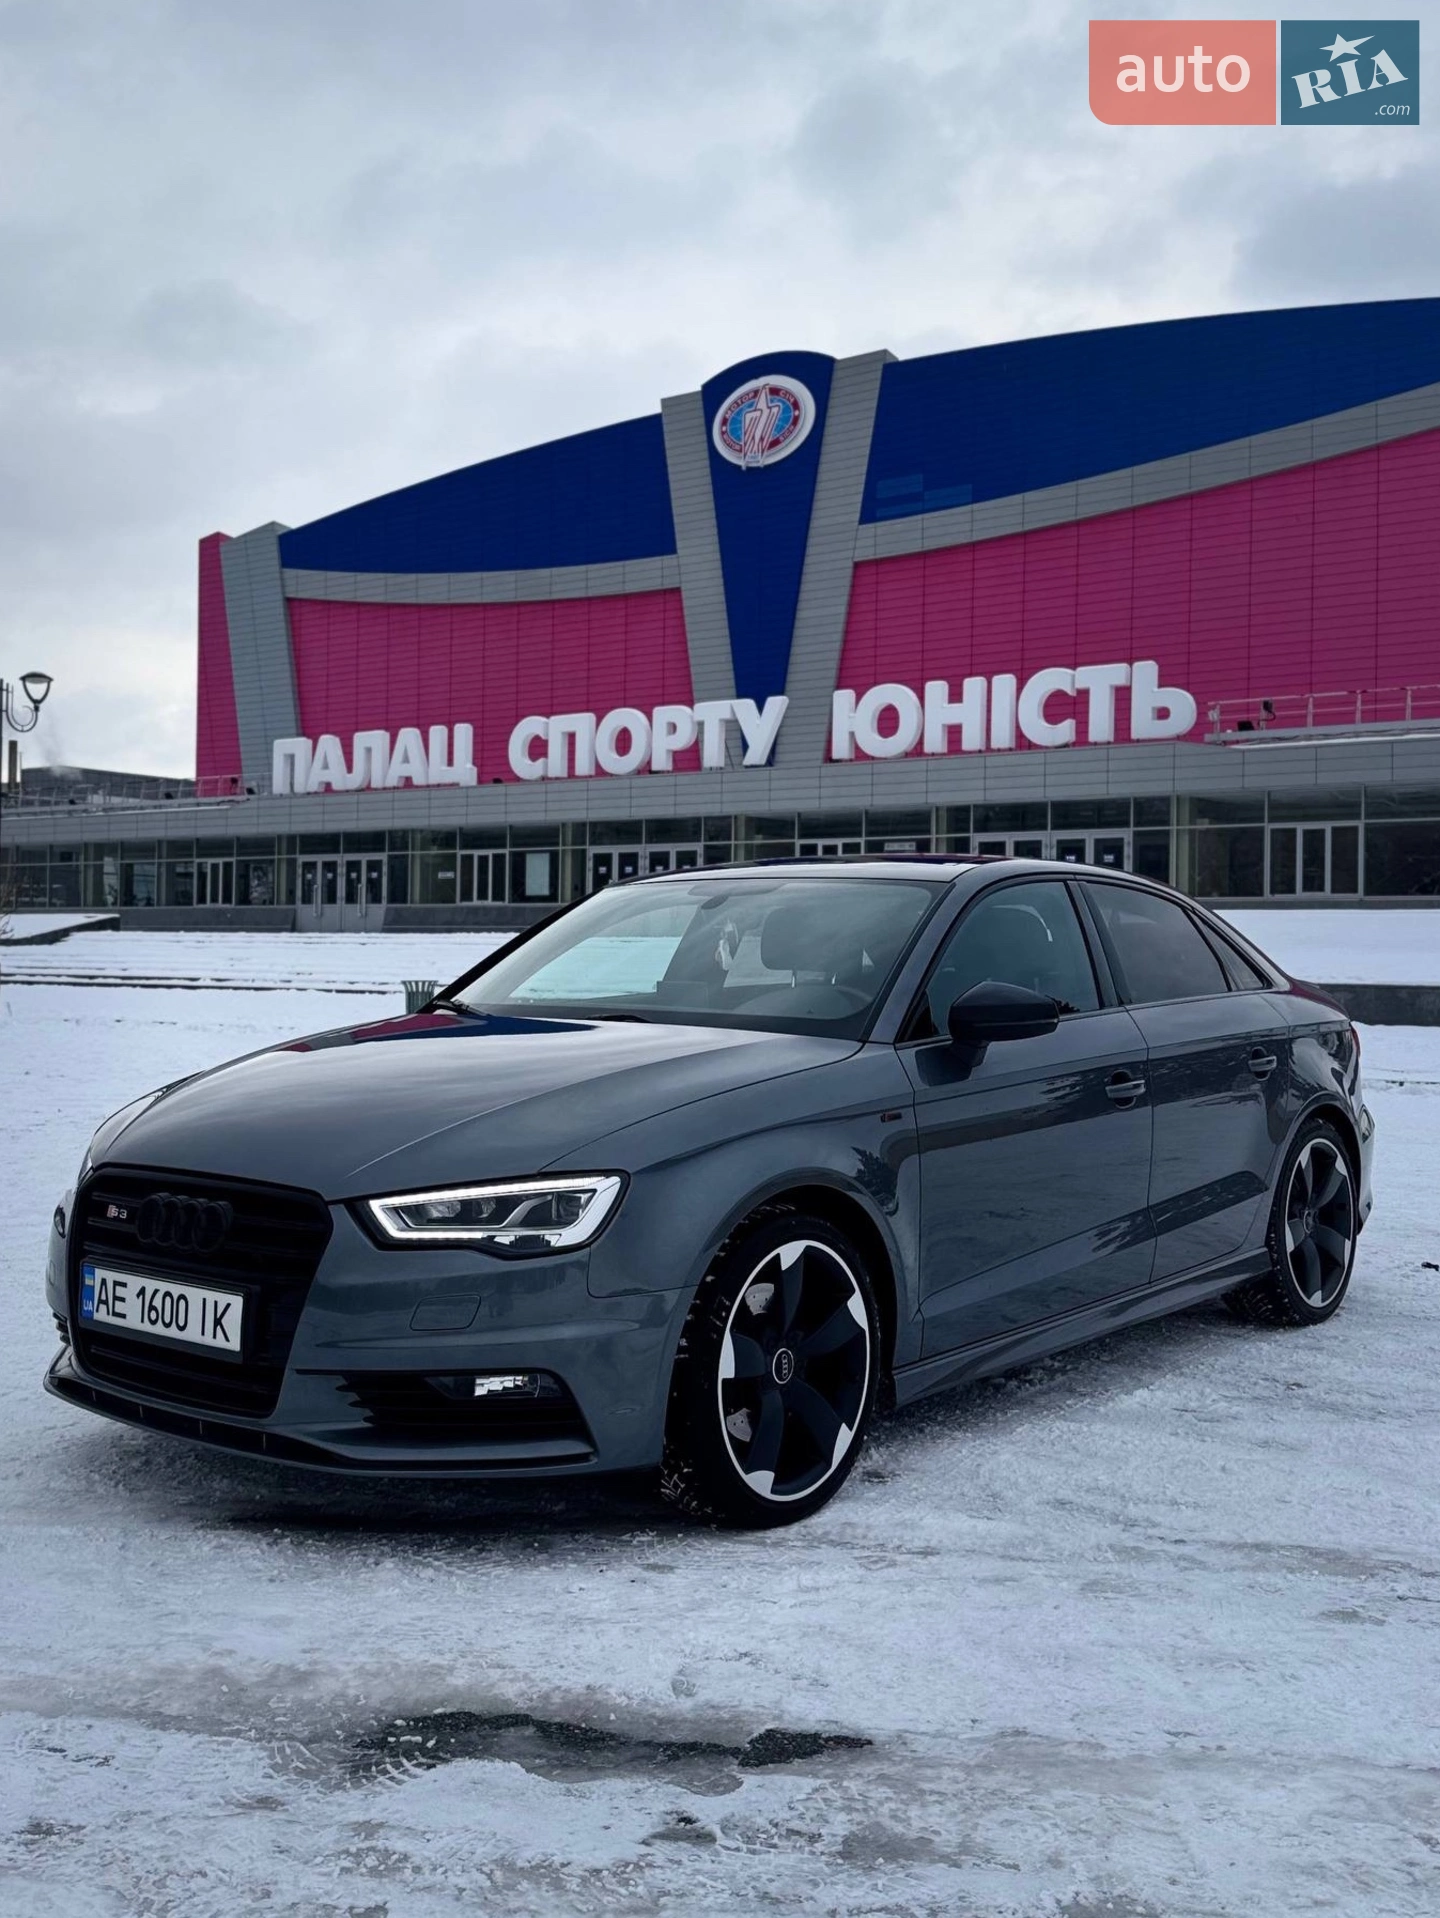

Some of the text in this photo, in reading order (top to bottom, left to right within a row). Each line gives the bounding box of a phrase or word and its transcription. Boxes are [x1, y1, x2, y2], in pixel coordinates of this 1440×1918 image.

[725, 391, 755, 419] МОТОР
[272, 660, 1198, 795] ПАЛАЦ СПОРТУ ЮНІСТЬ
[109, 1205, 128, 1219] S3
[83, 1298, 93, 1312] UA
[95, 1277, 232, 1343] AE 1600 IK
